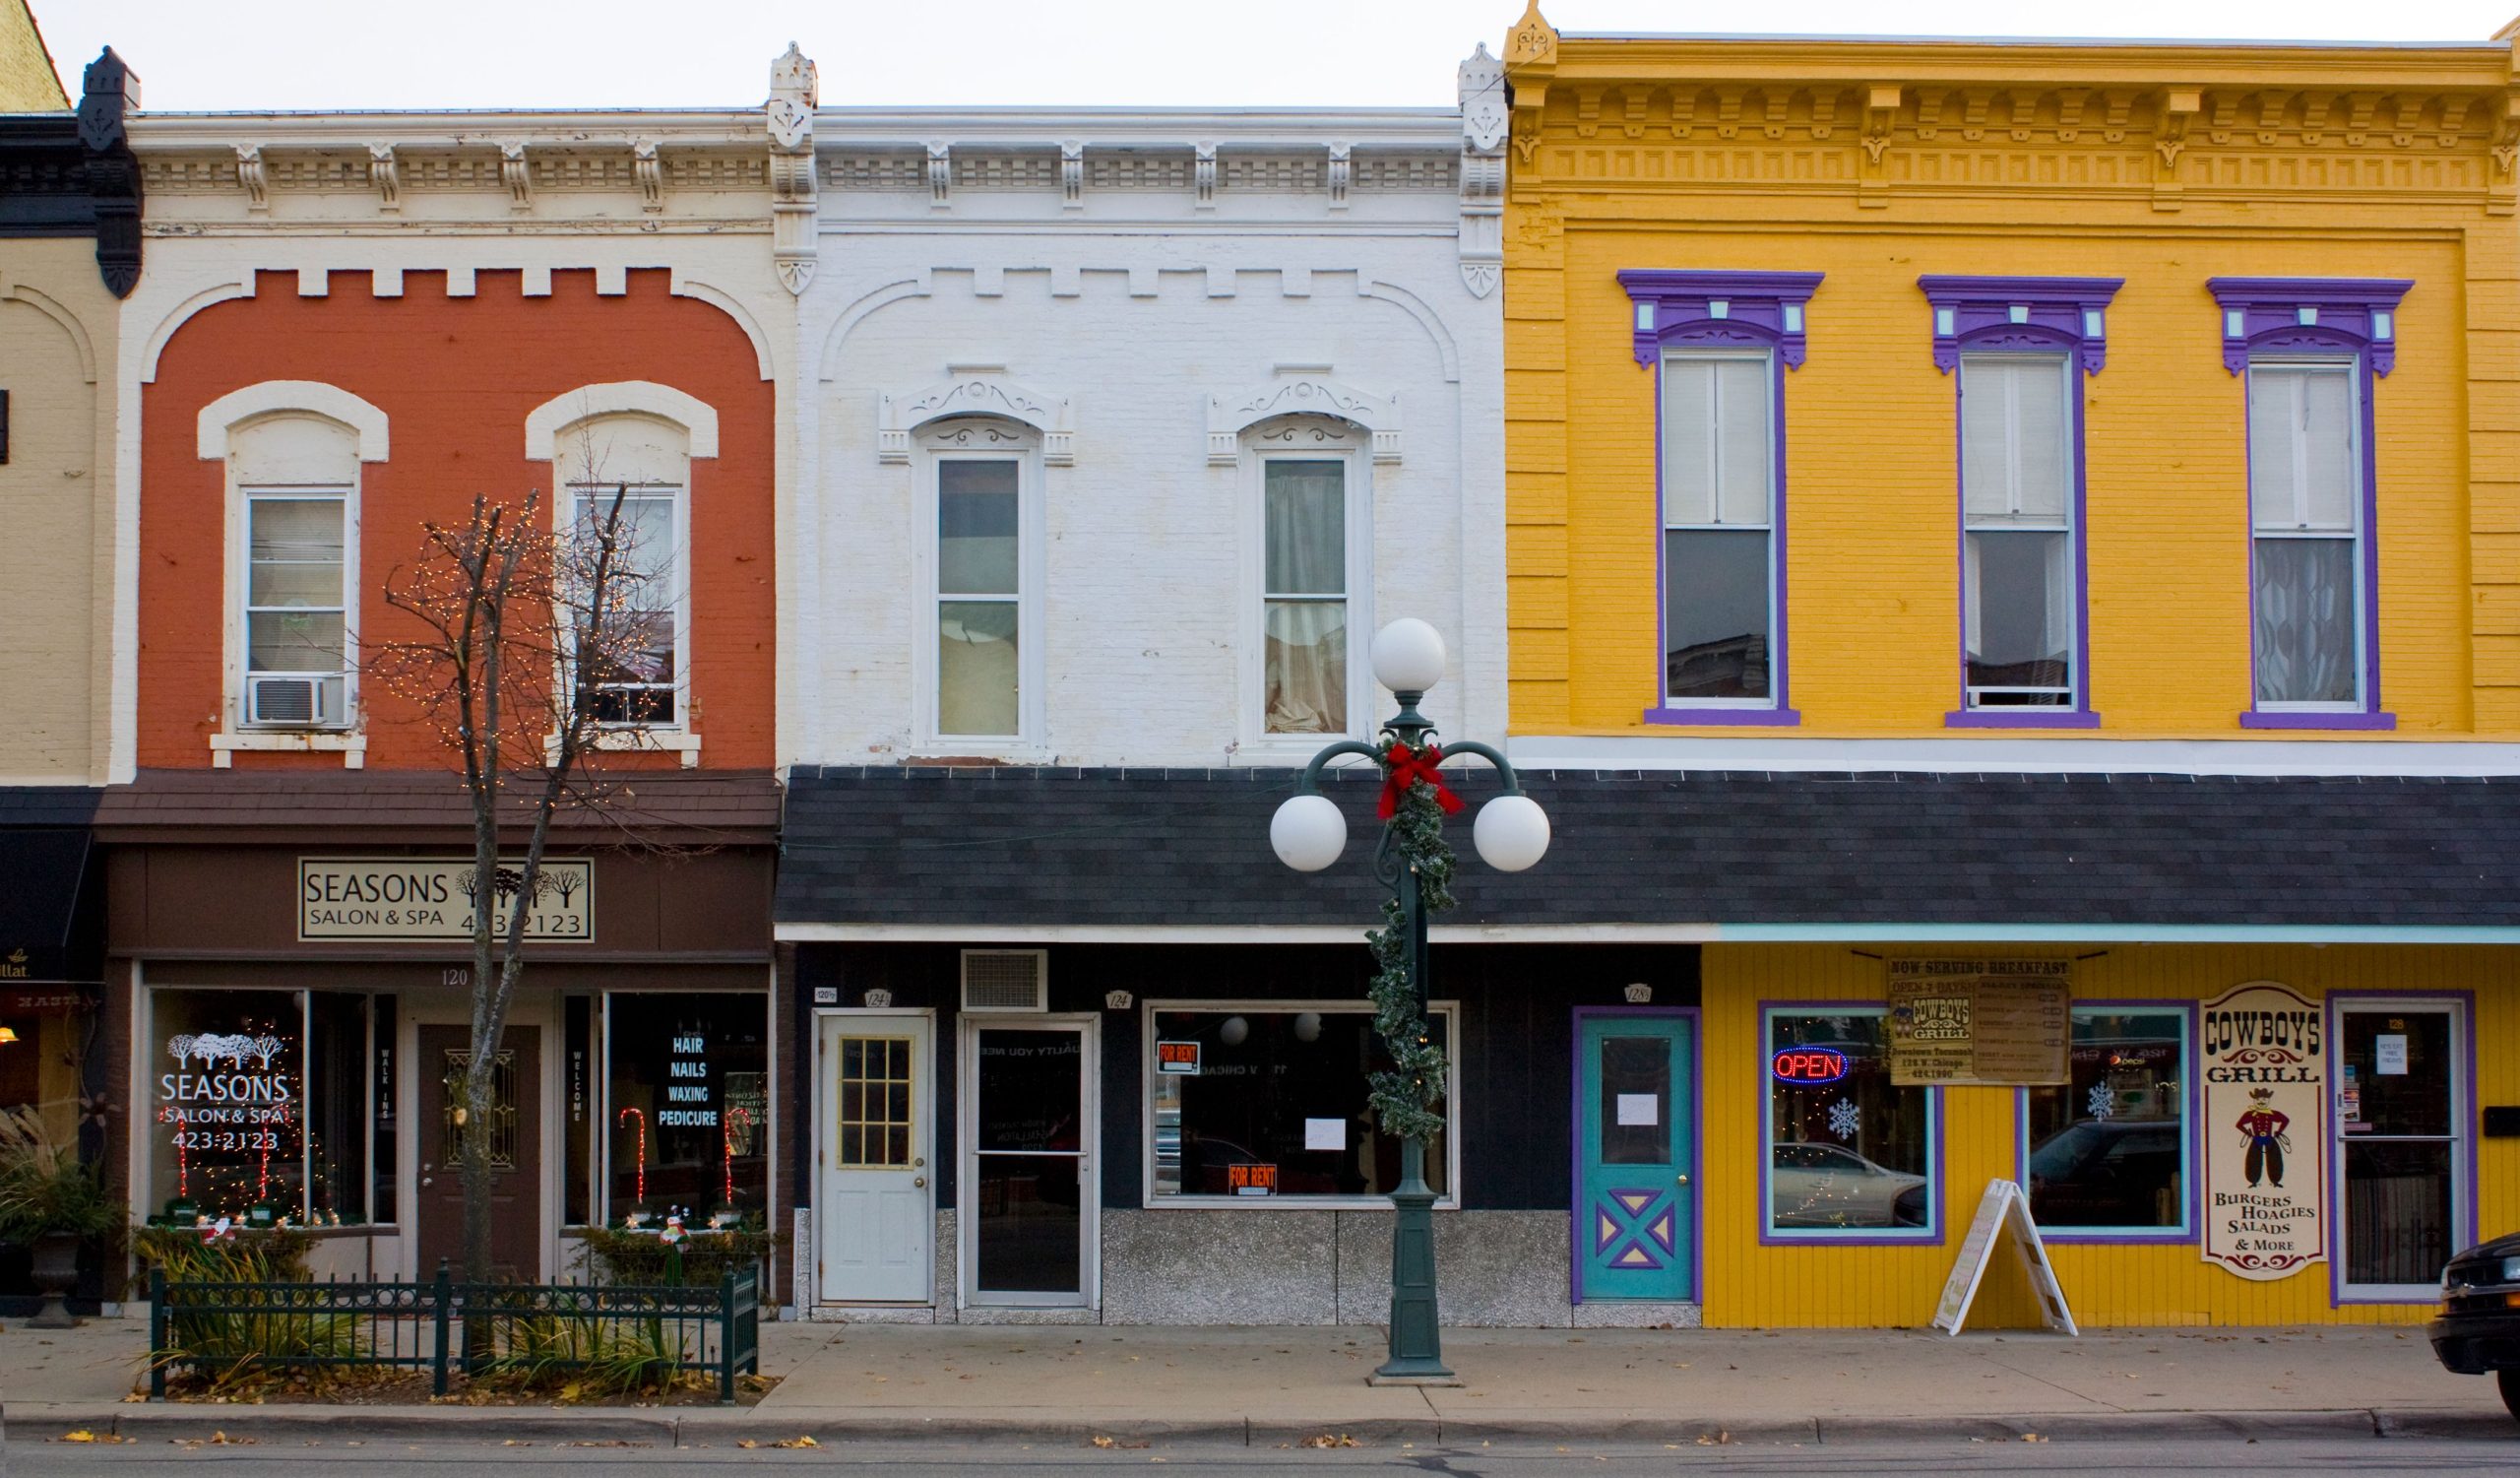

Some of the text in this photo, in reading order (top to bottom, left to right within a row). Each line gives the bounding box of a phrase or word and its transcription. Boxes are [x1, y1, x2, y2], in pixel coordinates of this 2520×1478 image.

[306, 873, 448, 903] SEASONS
[310, 909, 444, 926] SALON & SPA
[461, 914, 581, 933] 432123
[1891, 961, 2068, 976] NOW SERVING BREAKFAST
[443, 969, 468, 986] 120
[1893, 982, 1922, 994] OPEN
[1110, 995, 1127, 1006] 124
[1913, 997, 1970, 1025] COWBOYS
[2205, 1010, 2320, 1056] COWBOYS
[2388, 1019, 2404, 1030] 128
[1913, 1028, 1971, 1040] GRILL
[672, 1037, 704, 1054] HAIR
[1160, 1045, 1197, 1061] FOR RENT
[381, 1049, 390, 1084] WALK
[670, 1061, 707, 1078] NAILS
[1777, 1055, 1841, 1077] OPEN
[2206, 1066, 2320, 1083] GRILL
[160, 1073, 288, 1102] SEASONS
[573, 1051, 582, 1122] WELCOME
[667, 1086, 709, 1102] WAXING
[164, 1109, 284, 1124] SALON & SPA
[659, 1110, 718, 1126] PEDICURE
[1230, 1166, 1275, 1187] FOR RENT
[2215, 1192, 2292, 1207] BURGERS
[2240, 1205, 2315, 1220] HOAGIES
[2228, 1219, 2291, 1235] SALADS
[2235, 1239, 2295, 1252] & MORE
